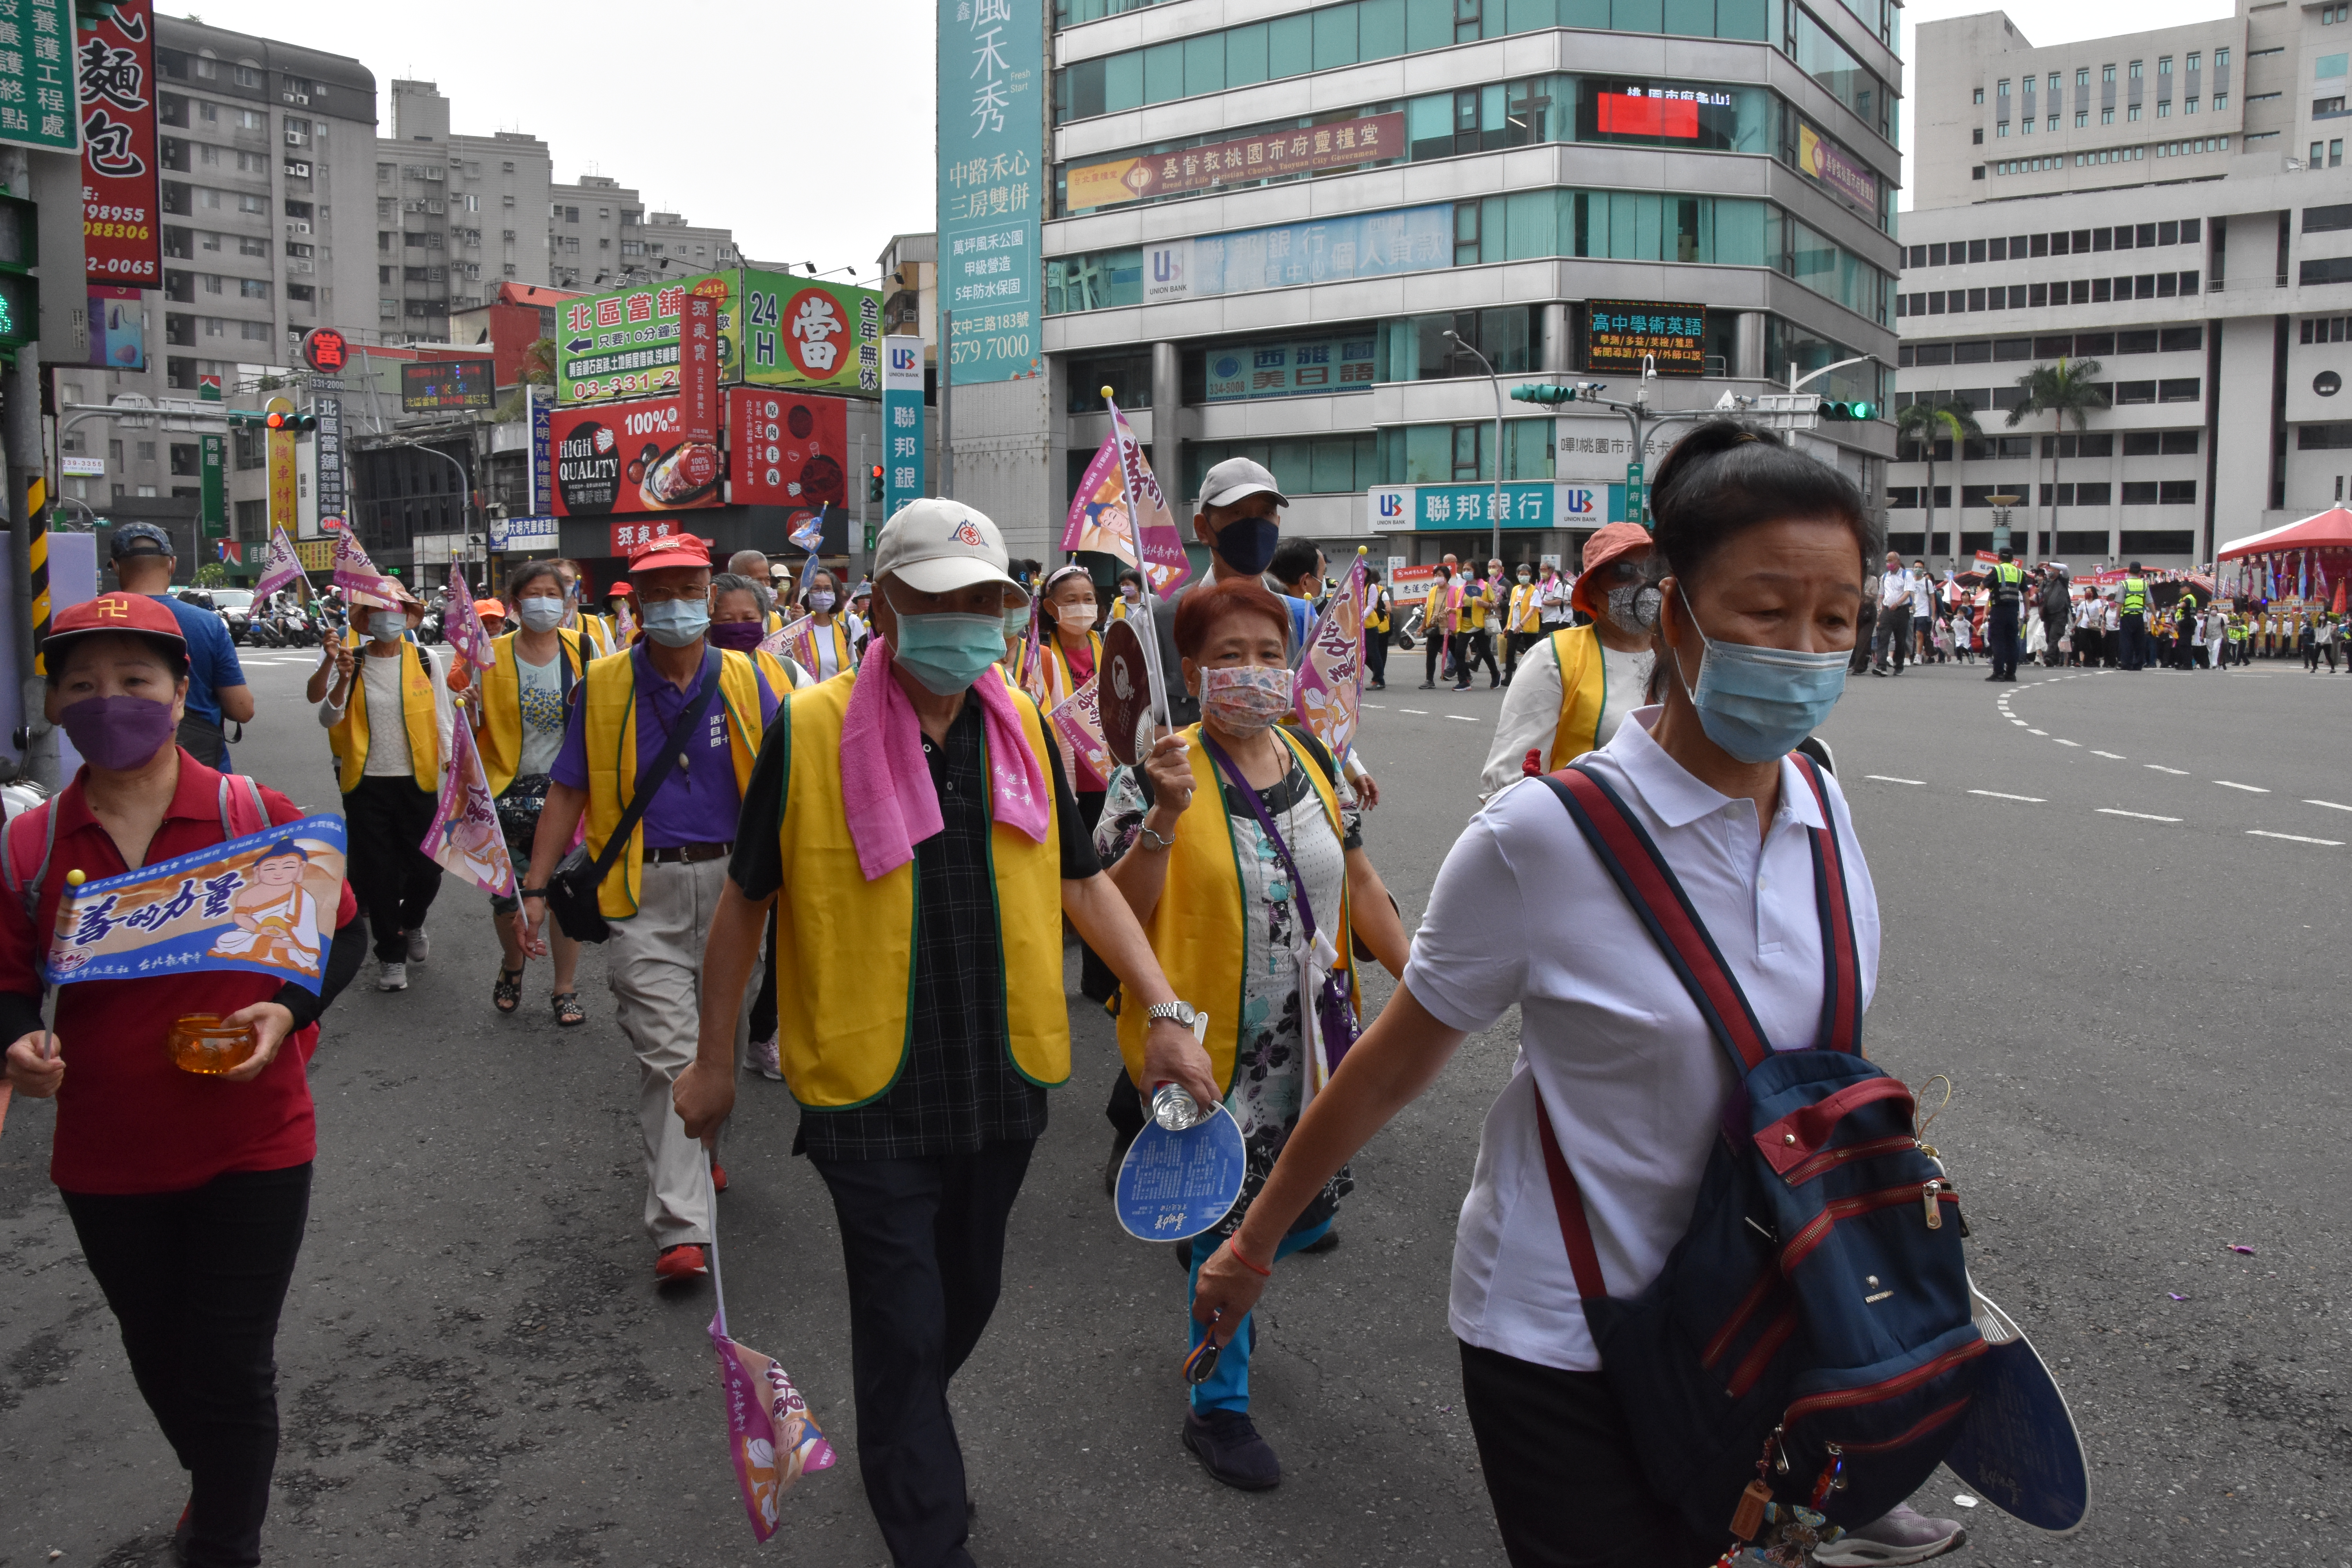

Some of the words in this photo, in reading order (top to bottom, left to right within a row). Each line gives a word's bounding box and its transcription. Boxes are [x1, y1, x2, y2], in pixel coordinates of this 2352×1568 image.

[957, 0, 971, 22] 鑫
[1010, 82, 1028, 93] Start
[1011, 69, 1031, 81] Fresh
[1162, 123, 1378, 180] 基督教桃園市府靈糧堂
[950, 149, 1030, 189] 中路禾心
[1162, 180, 1182, 189] Bread
[1248, 166, 1275, 175] Church,
[1279, 158, 1308, 171] Taoyuan
[1313, 156, 1327, 165] City
[1331, 149, 1377, 162] Government
[949, 182, 1030, 220] 三房雙併
[953, 230, 1023, 256] 萬坪風禾公園
[964, 255, 1011, 277] 甲級營造
[695, 285, 724, 297] 24H
[956, 278, 1020, 301] 5年防水保固
[1149, 286, 1169, 295] UNION
[1170, 284, 1187, 293] BANK
[750, 290, 778, 328] 24
[692, 301, 710, 361] 孫東寶
[792, 297, 842, 370] 當
[951, 311, 1029, 336] 文中三路183號
[1592, 313, 1702, 336] 高中學術英語
[314, 334, 341, 366] 當
[756, 331, 775, 366] H
[860, 296, 879, 390] 全年無休
[986, 334, 1029, 360] 7000
[312, 379, 344, 390] 331-2000
[1209, 381, 1245, 395] 334-5008
[1253, 363, 1374, 390] 美日語
[319, 400, 338, 470] 北區當舖
[625, 409, 668, 436] 100%
[207, 439, 219, 466] 房屋
[559, 438, 592, 458] HIGH
[756, 444, 762, 459] 味道
[767, 404, 778, 484] 原肉主義
[559, 459, 618, 480] QUALITY
[691, 457, 708, 465] 100%
[321, 494, 340, 503] 汽車
[1426, 493, 1543, 521] 聯邦銀行
[1629, 476, 1640, 518] 縣府路
[323, 519, 340, 530] 24H
[510, 519, 558, 535] 大明汽車修理廠
[618, 523, 669, 546] 孫東寶
[993, 784, 1031, 806] 雲寺
[57, 871, 244, 945] 善的力量
[138, 952, 201, 971] 台北龍雲寺
